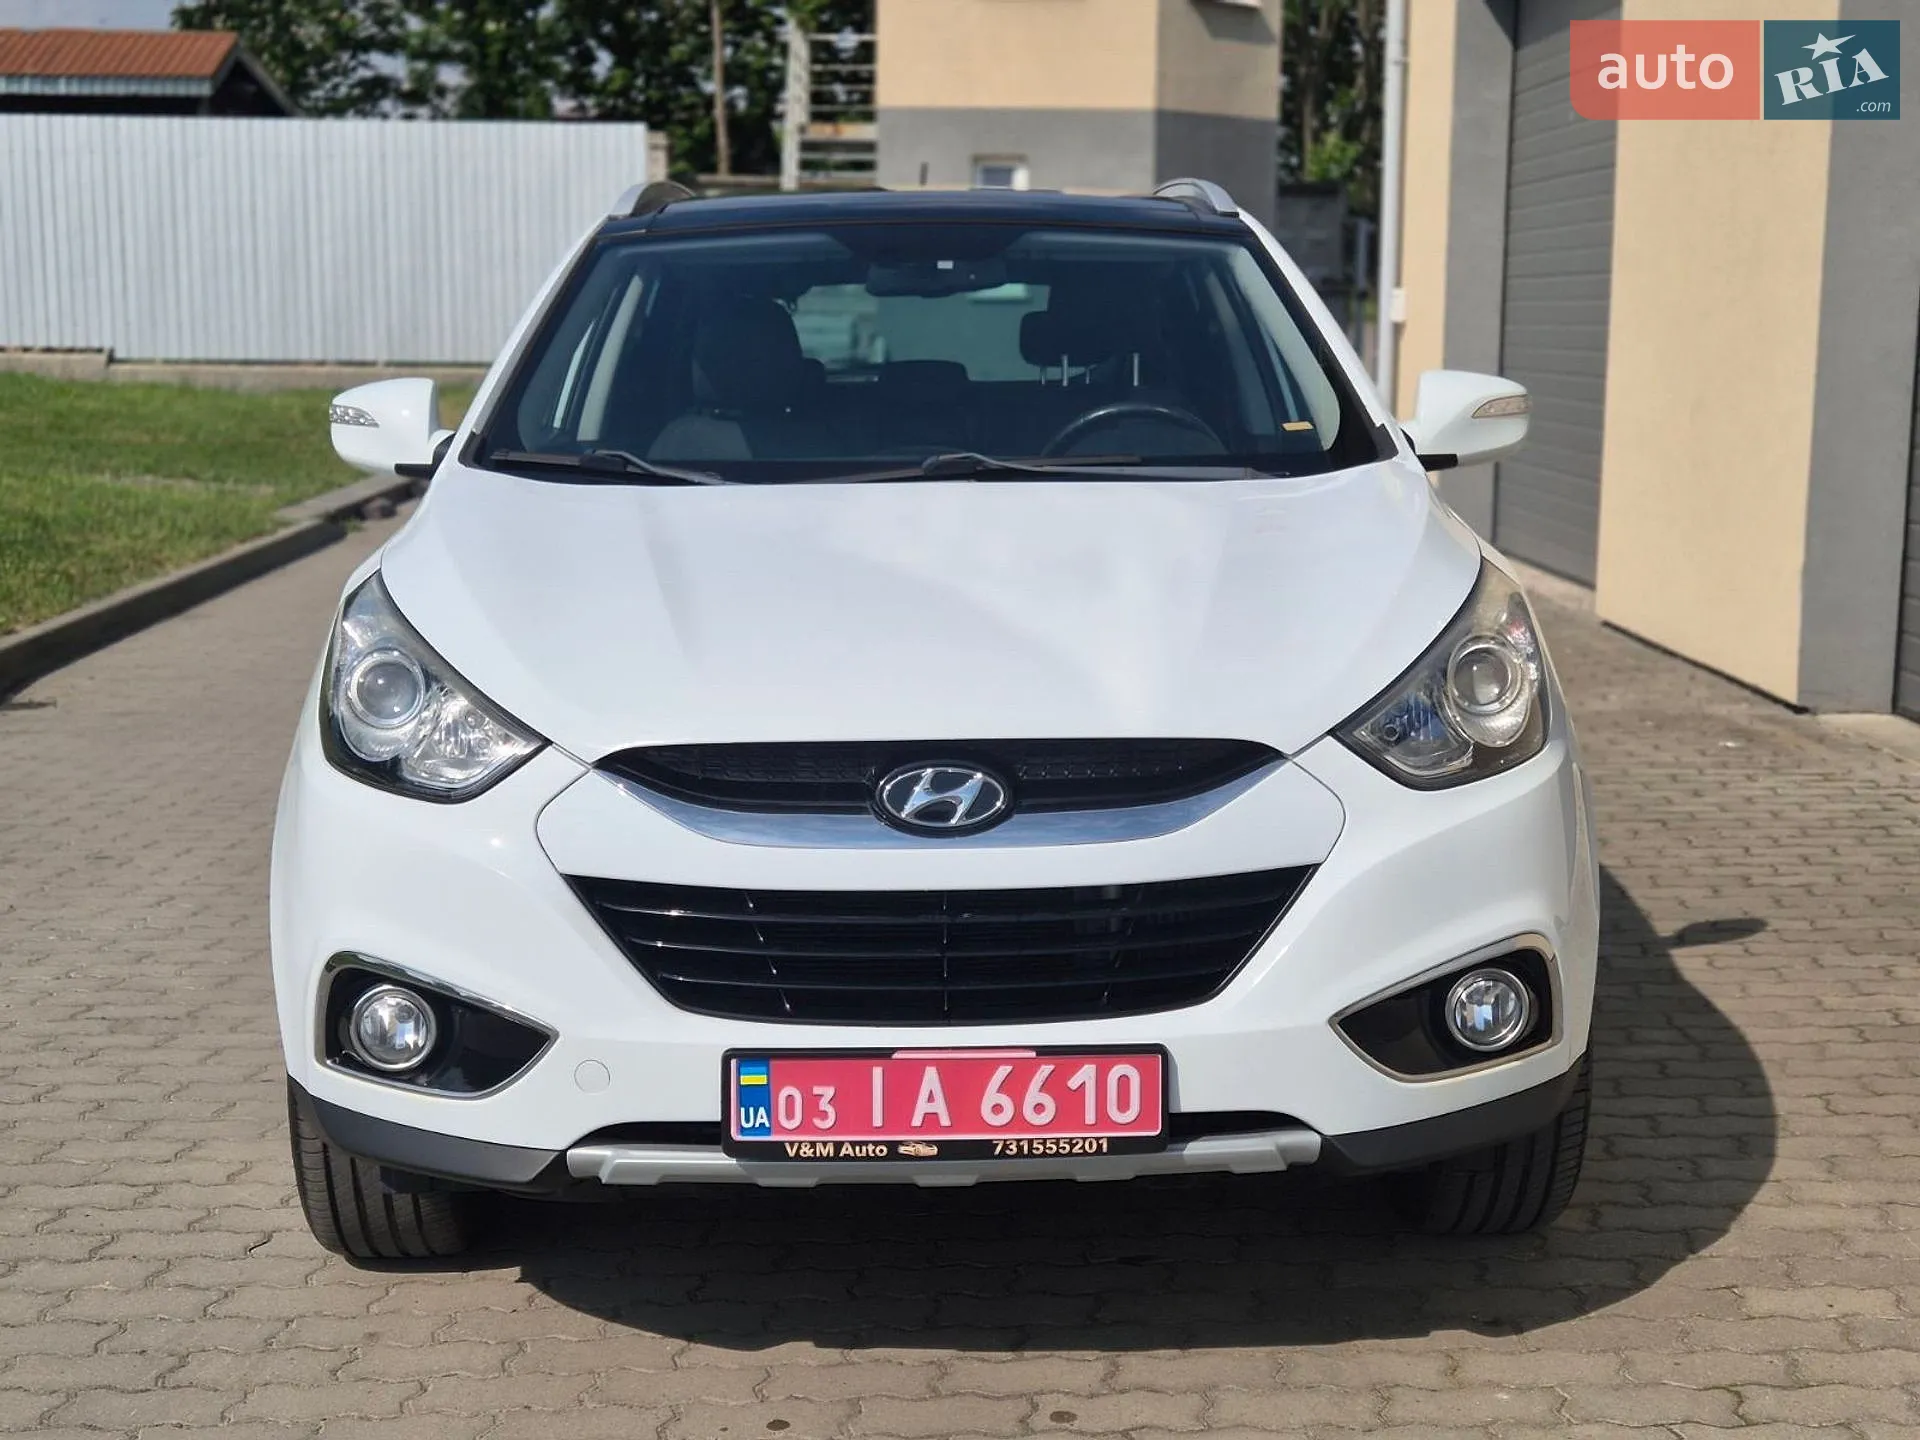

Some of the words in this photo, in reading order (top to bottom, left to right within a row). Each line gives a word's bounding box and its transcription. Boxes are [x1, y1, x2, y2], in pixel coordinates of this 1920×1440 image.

[777, 1085, 837, 1130] 03
[980, 1064, 1141, 1127] 6610
[740, 1106, 770, 1128] UA
[784, 1142, 835, 1157] V&M
[839, 1142, 888, 1157] Auto
[992, 1137, 1109, 1156] 731555201
